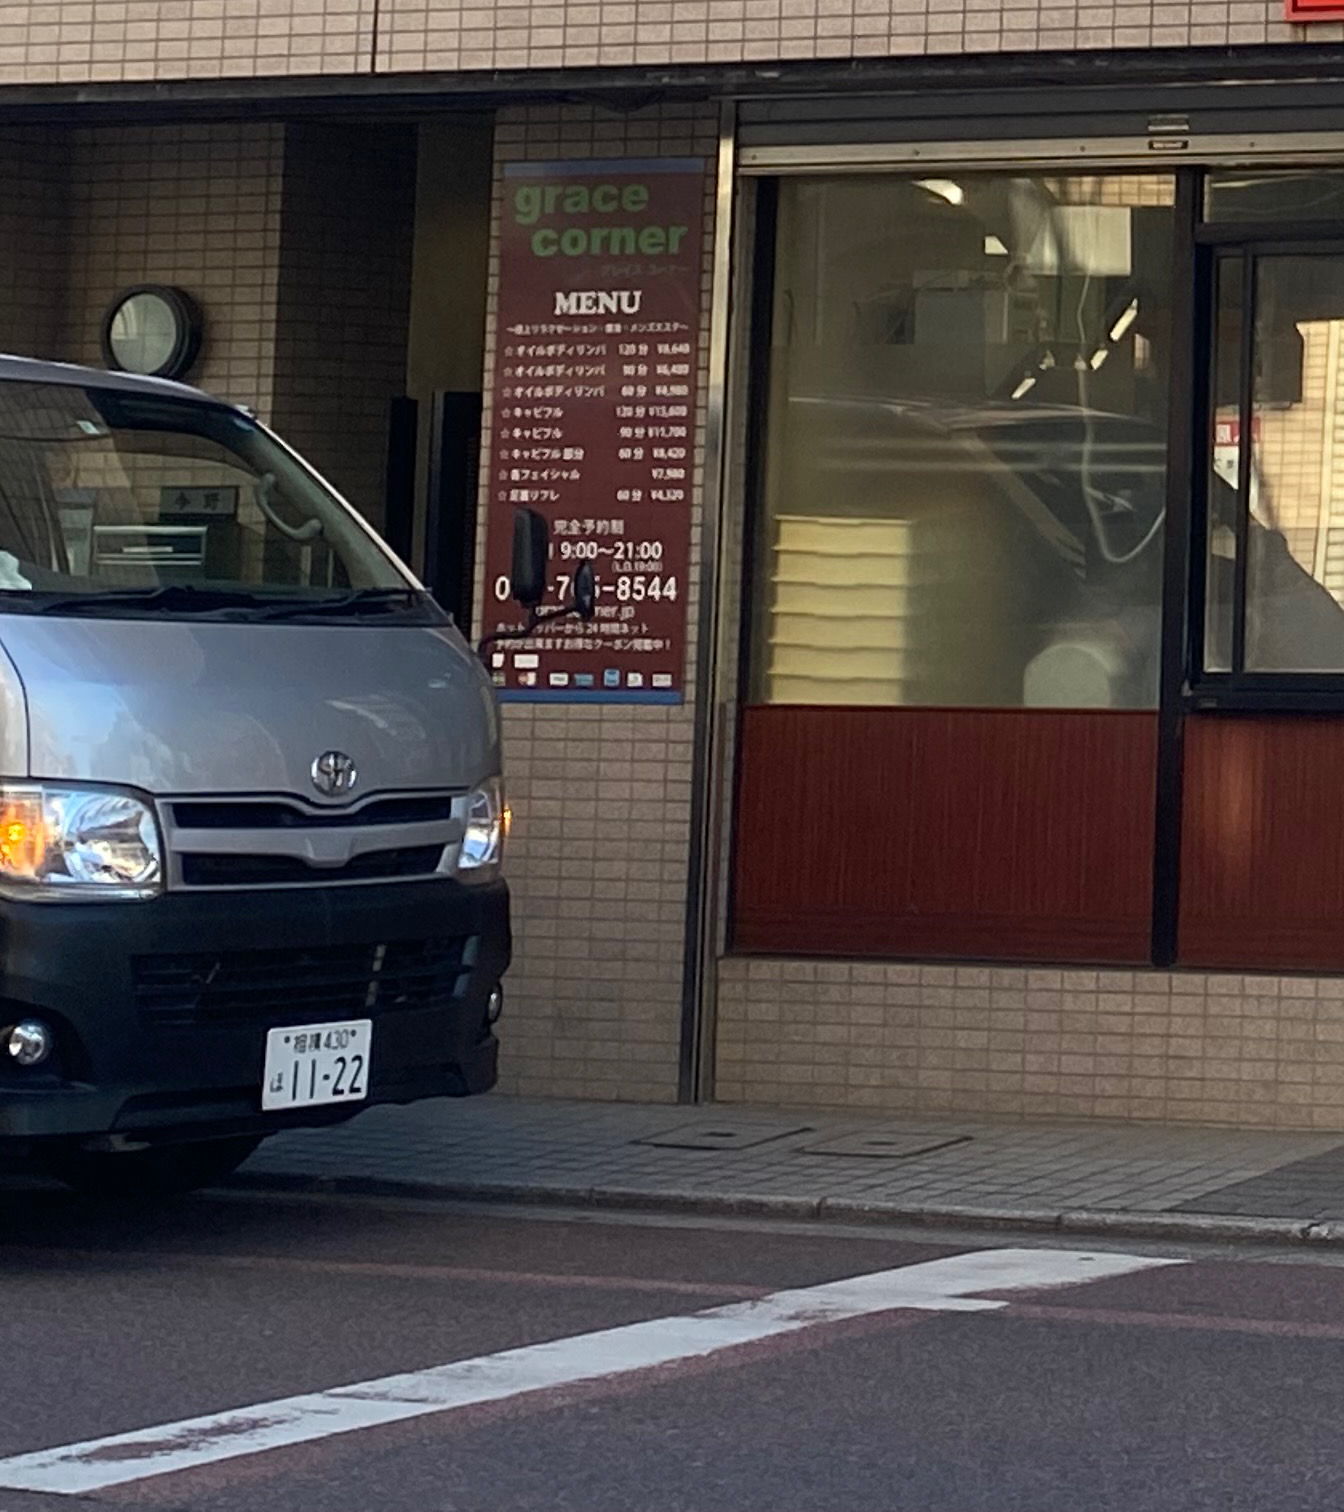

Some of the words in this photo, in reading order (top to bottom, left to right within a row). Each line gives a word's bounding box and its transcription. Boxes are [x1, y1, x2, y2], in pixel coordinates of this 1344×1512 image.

[515, 184, 648, 225] grace
[531, 225, 689, 257] corner
[554, 290, 642, 315] MENU
[495, 576, 677, 601] 0-7-8544
